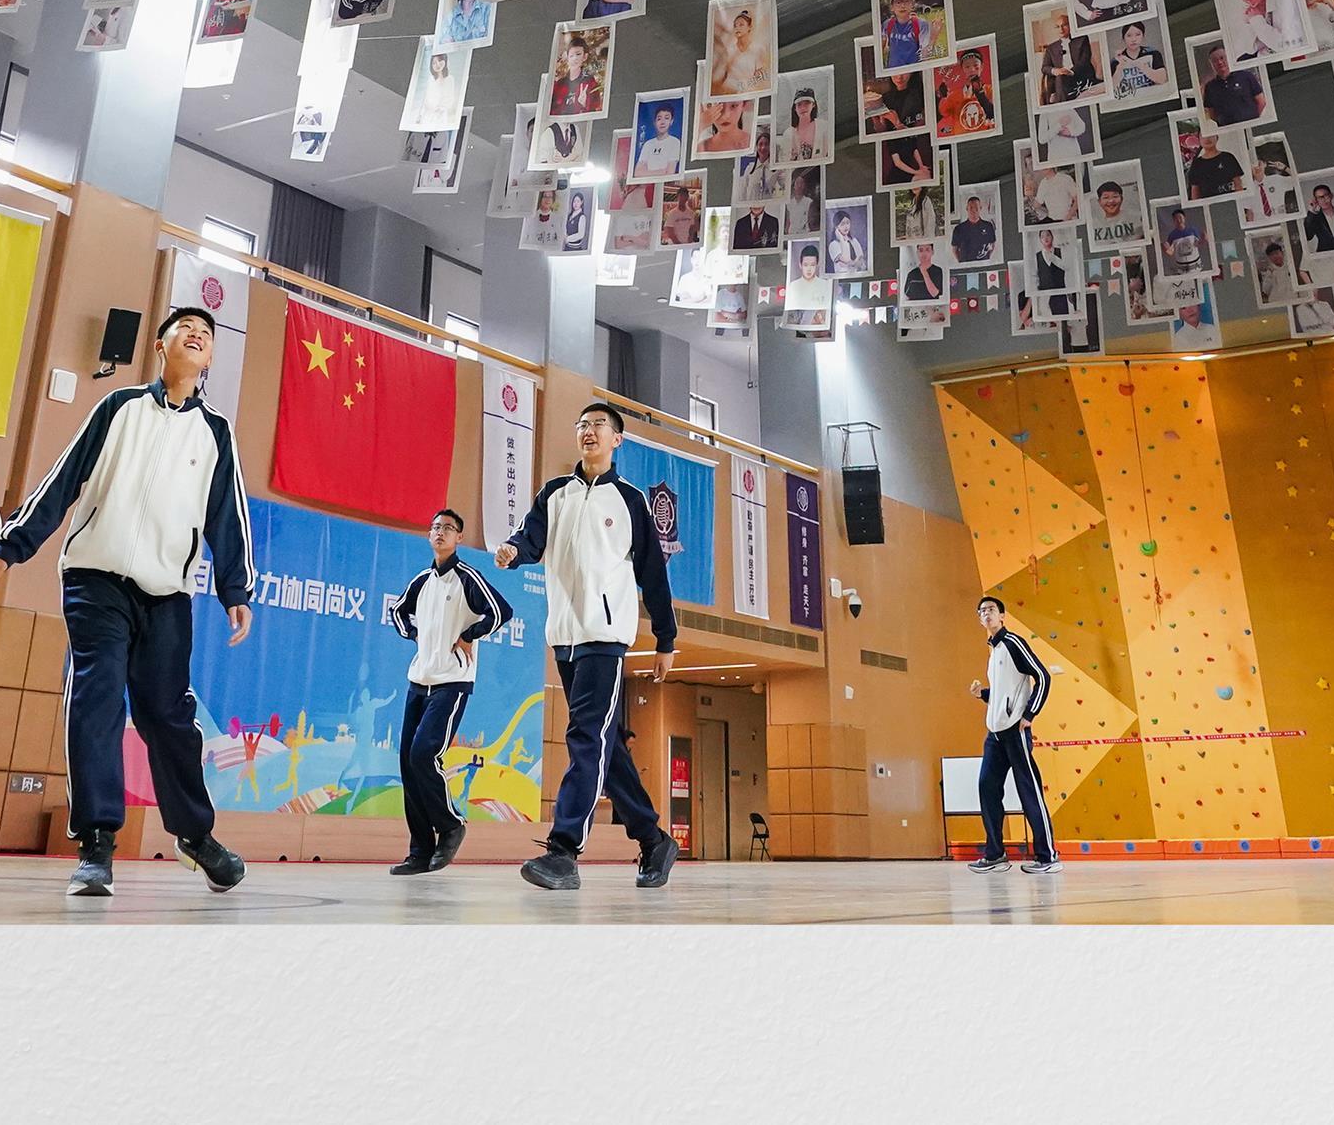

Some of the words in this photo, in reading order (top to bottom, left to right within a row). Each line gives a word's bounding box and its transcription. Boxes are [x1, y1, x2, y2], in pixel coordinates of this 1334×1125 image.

[506, 436, 516, 535] 做杰出的中国
